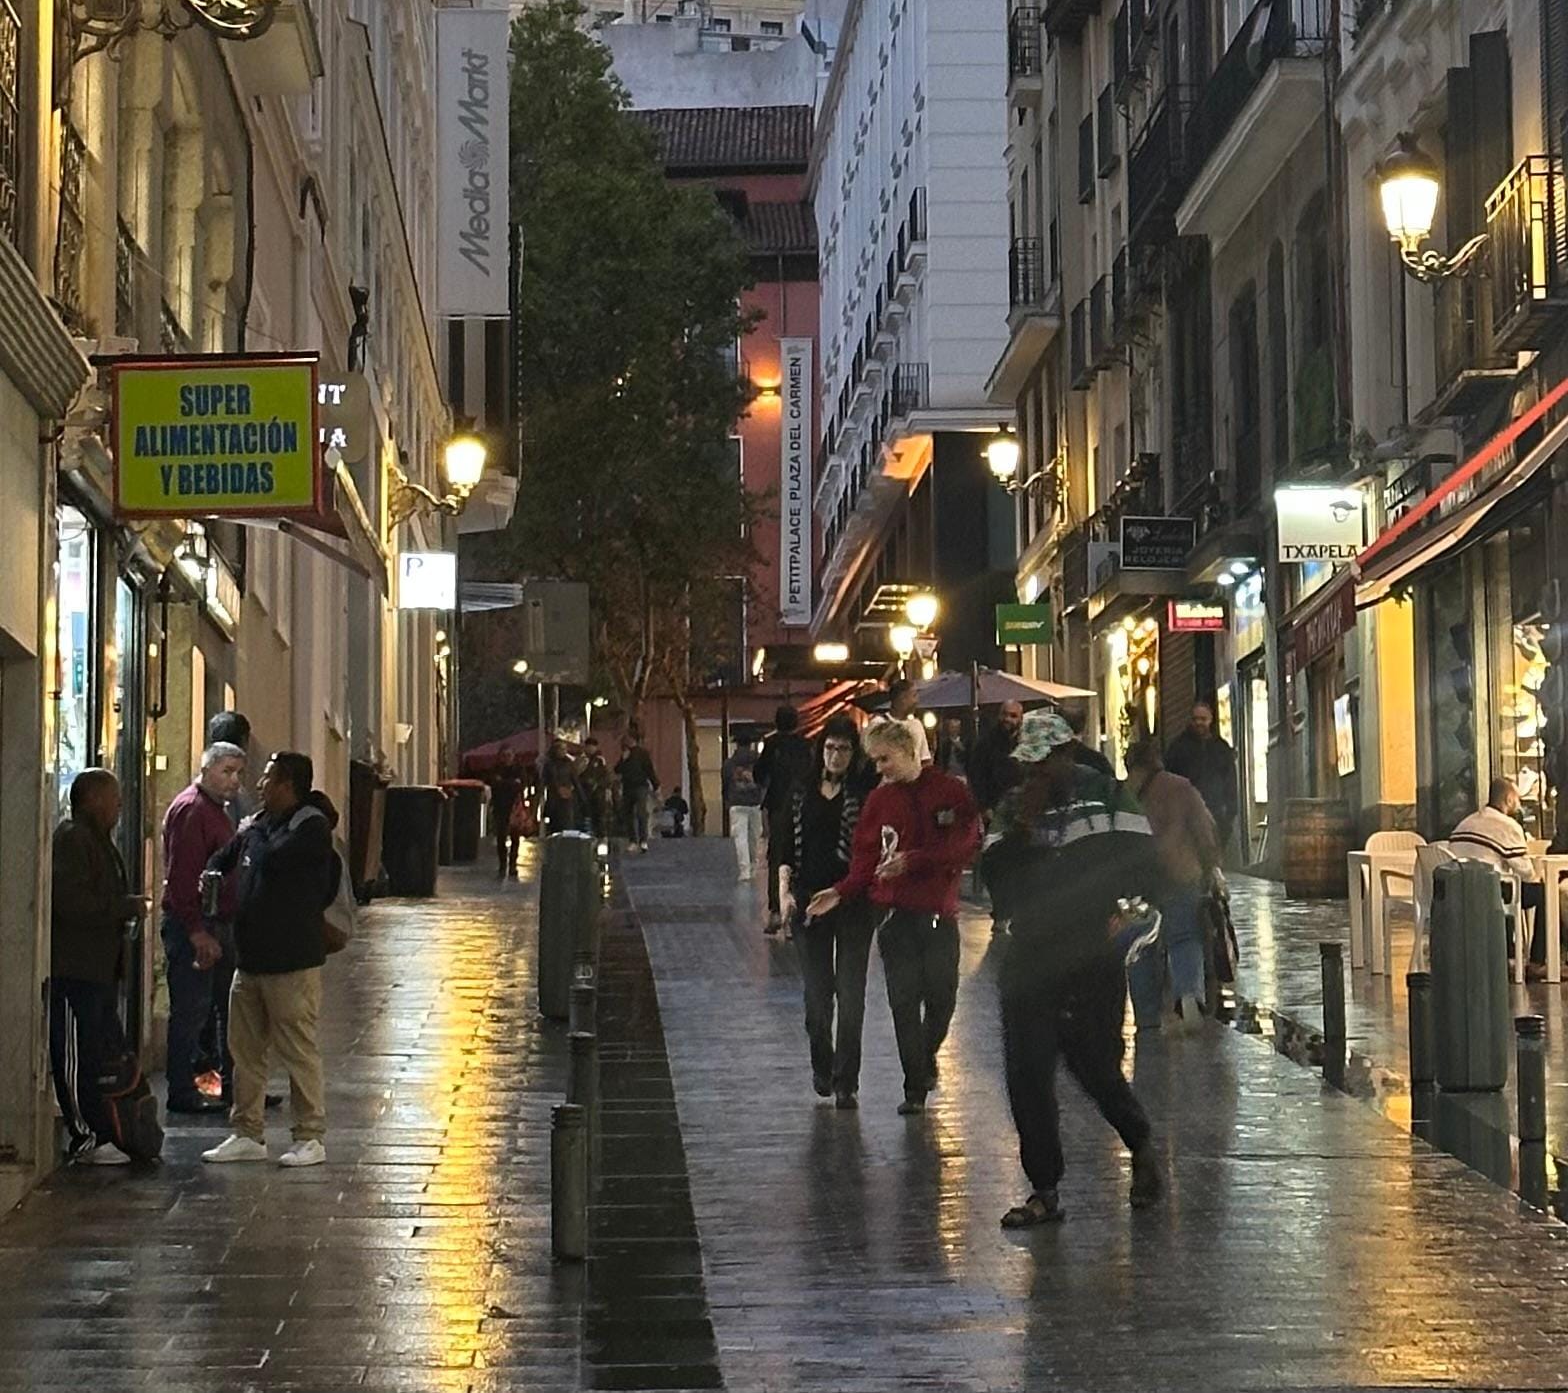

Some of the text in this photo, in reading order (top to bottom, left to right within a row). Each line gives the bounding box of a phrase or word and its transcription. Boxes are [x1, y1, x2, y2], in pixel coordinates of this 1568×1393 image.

[180, 384, 251, 417] SUPER
[134, 416, 298, 457] ALIMENTACIÓN
[161, 462, 274, 496] Y BEBIDAS
[789, 357, 801, 604] PETITPALACE PLAZA DEL CARMEN
[1282, 544, 1358, 559] TXAPELA
